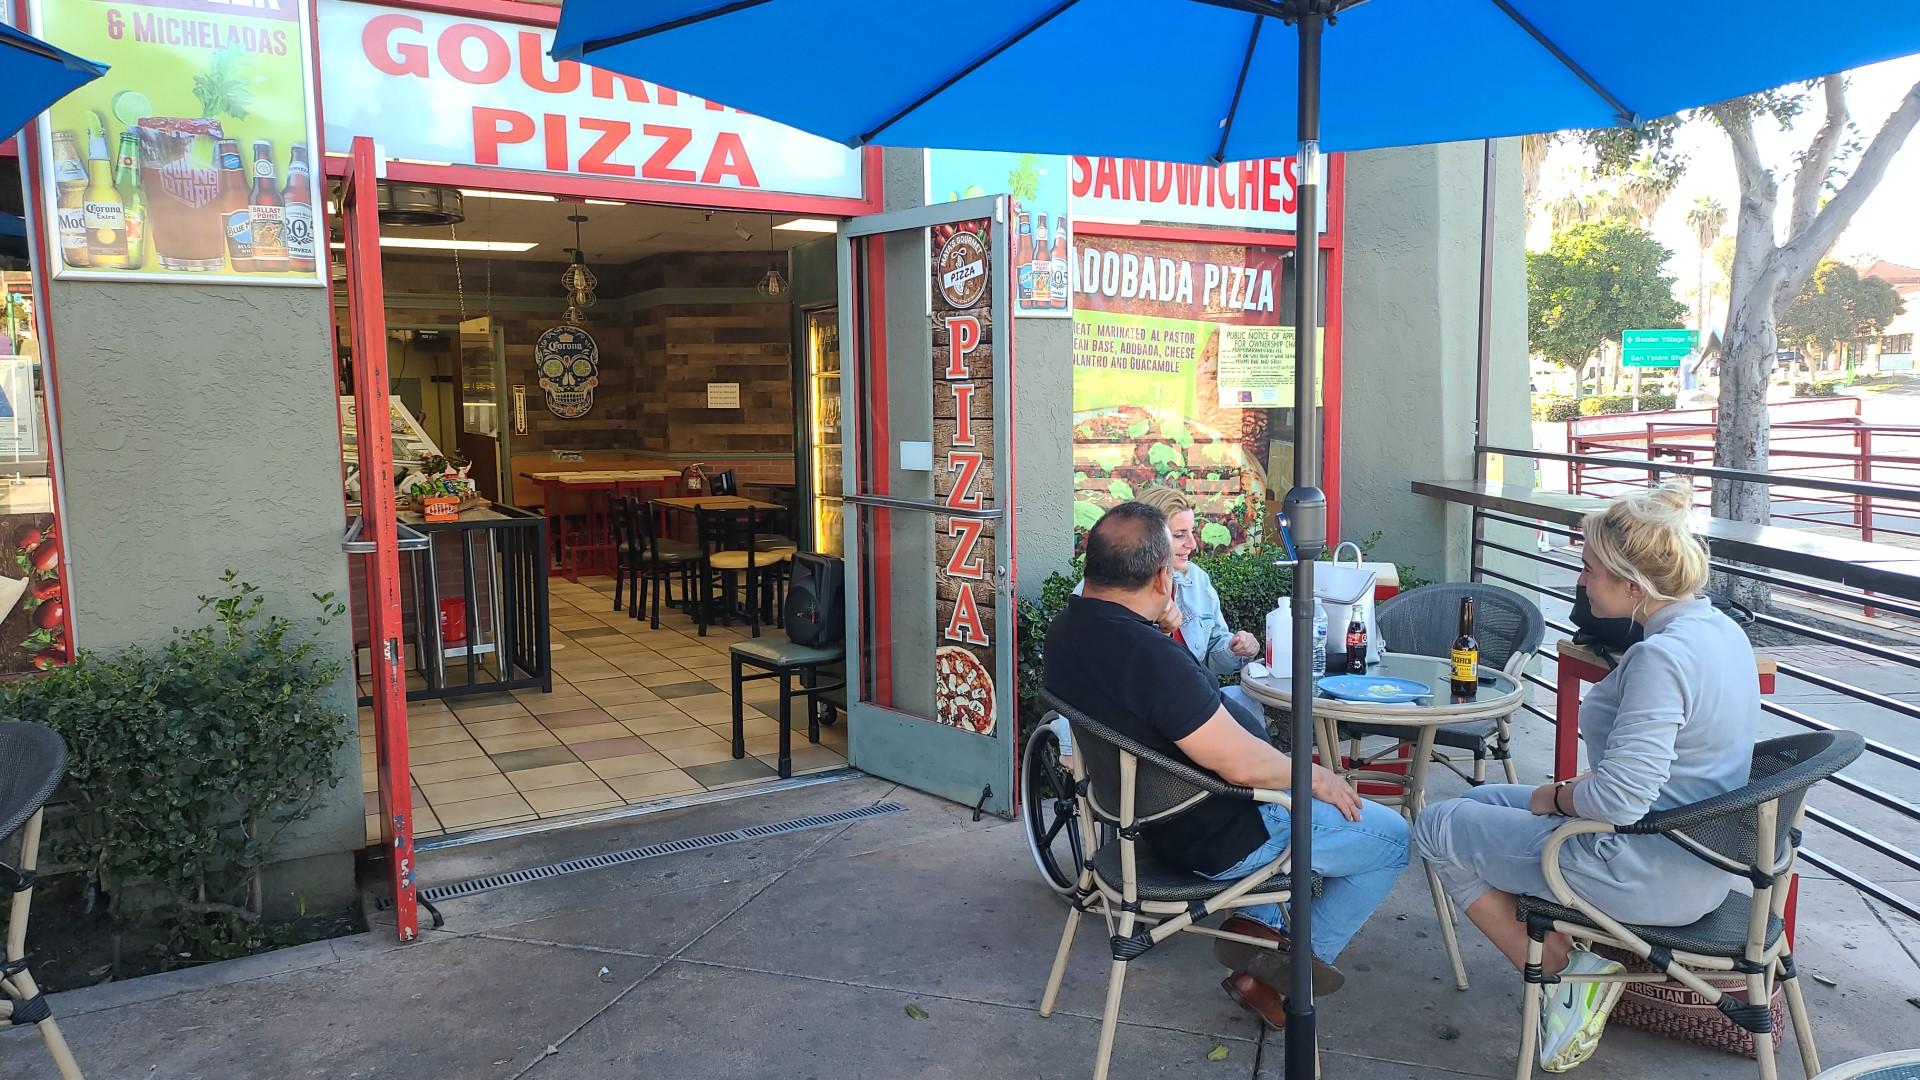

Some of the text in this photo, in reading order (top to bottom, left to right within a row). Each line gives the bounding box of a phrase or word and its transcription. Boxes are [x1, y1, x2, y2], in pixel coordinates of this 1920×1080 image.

[106, 9, 288, 57] & MICHELADAS
[361, 13, 751, 114] GOUR
[472, 106, 760, 188] PIZZA
[1072, 155, 1297, 214] SANDWICHES
[86, 203, 122, 214] Corona
[252, 206, 281, 214] BALLAST
[956, 235, 983, 256] GOURMET
[950, 265, 976, 283] PIZZA
[1202, 263, 1274, 312] PIZZA
[1073, 320, 1195, 345] EAT MARINATED AL PASTOR
[1226, 332, 1296, 340] PUBLIC NOTICE OF APPL
[1662, 336, 1686, 344] Village
[548, 340, 582, 352] Corona
[1073, 338, 1196, 359] EAN BASE, ADOBADA, CHEESE
[1234, 340, 1246, 348] FOR
[1248, 340, 1284, 348] OWNERSHIP
[1073, 354, 1180, 373] ILANTRO AND GUACAMOLE
[944, 314, 990, 647] PIZZA
[1625, 982, 1684, 1004] HRISTIAN
